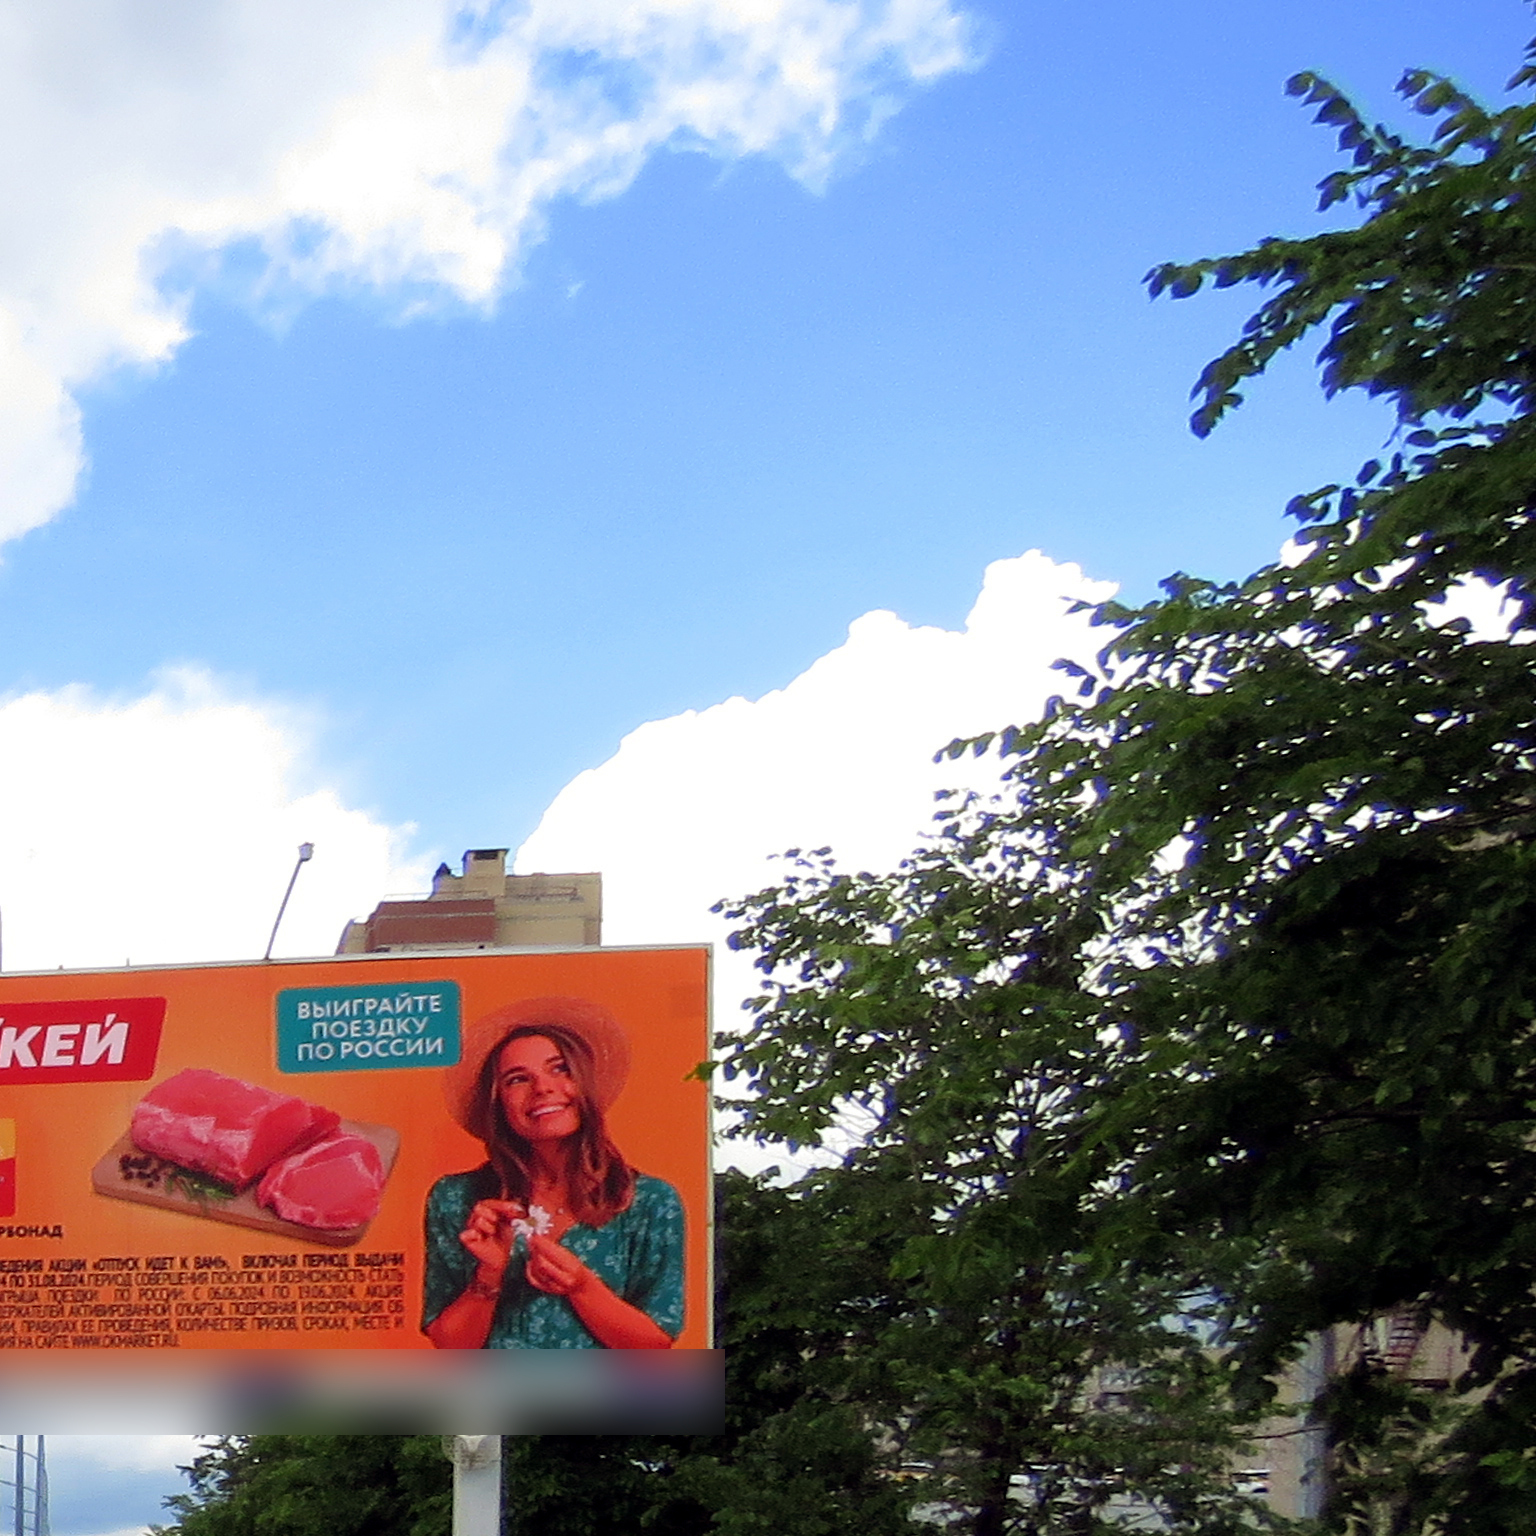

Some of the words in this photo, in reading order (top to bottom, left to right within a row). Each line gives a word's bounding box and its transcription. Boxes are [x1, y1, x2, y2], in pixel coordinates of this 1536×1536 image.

[297, 992, 442, 1019] ВЫИГРАЙТЕ
[312, 1016, 428, 1039] ПОЕЗДКУ
[298, 1042, 334, 1061] ПО
[341, 1037, 444, 1058] РОССИИ
